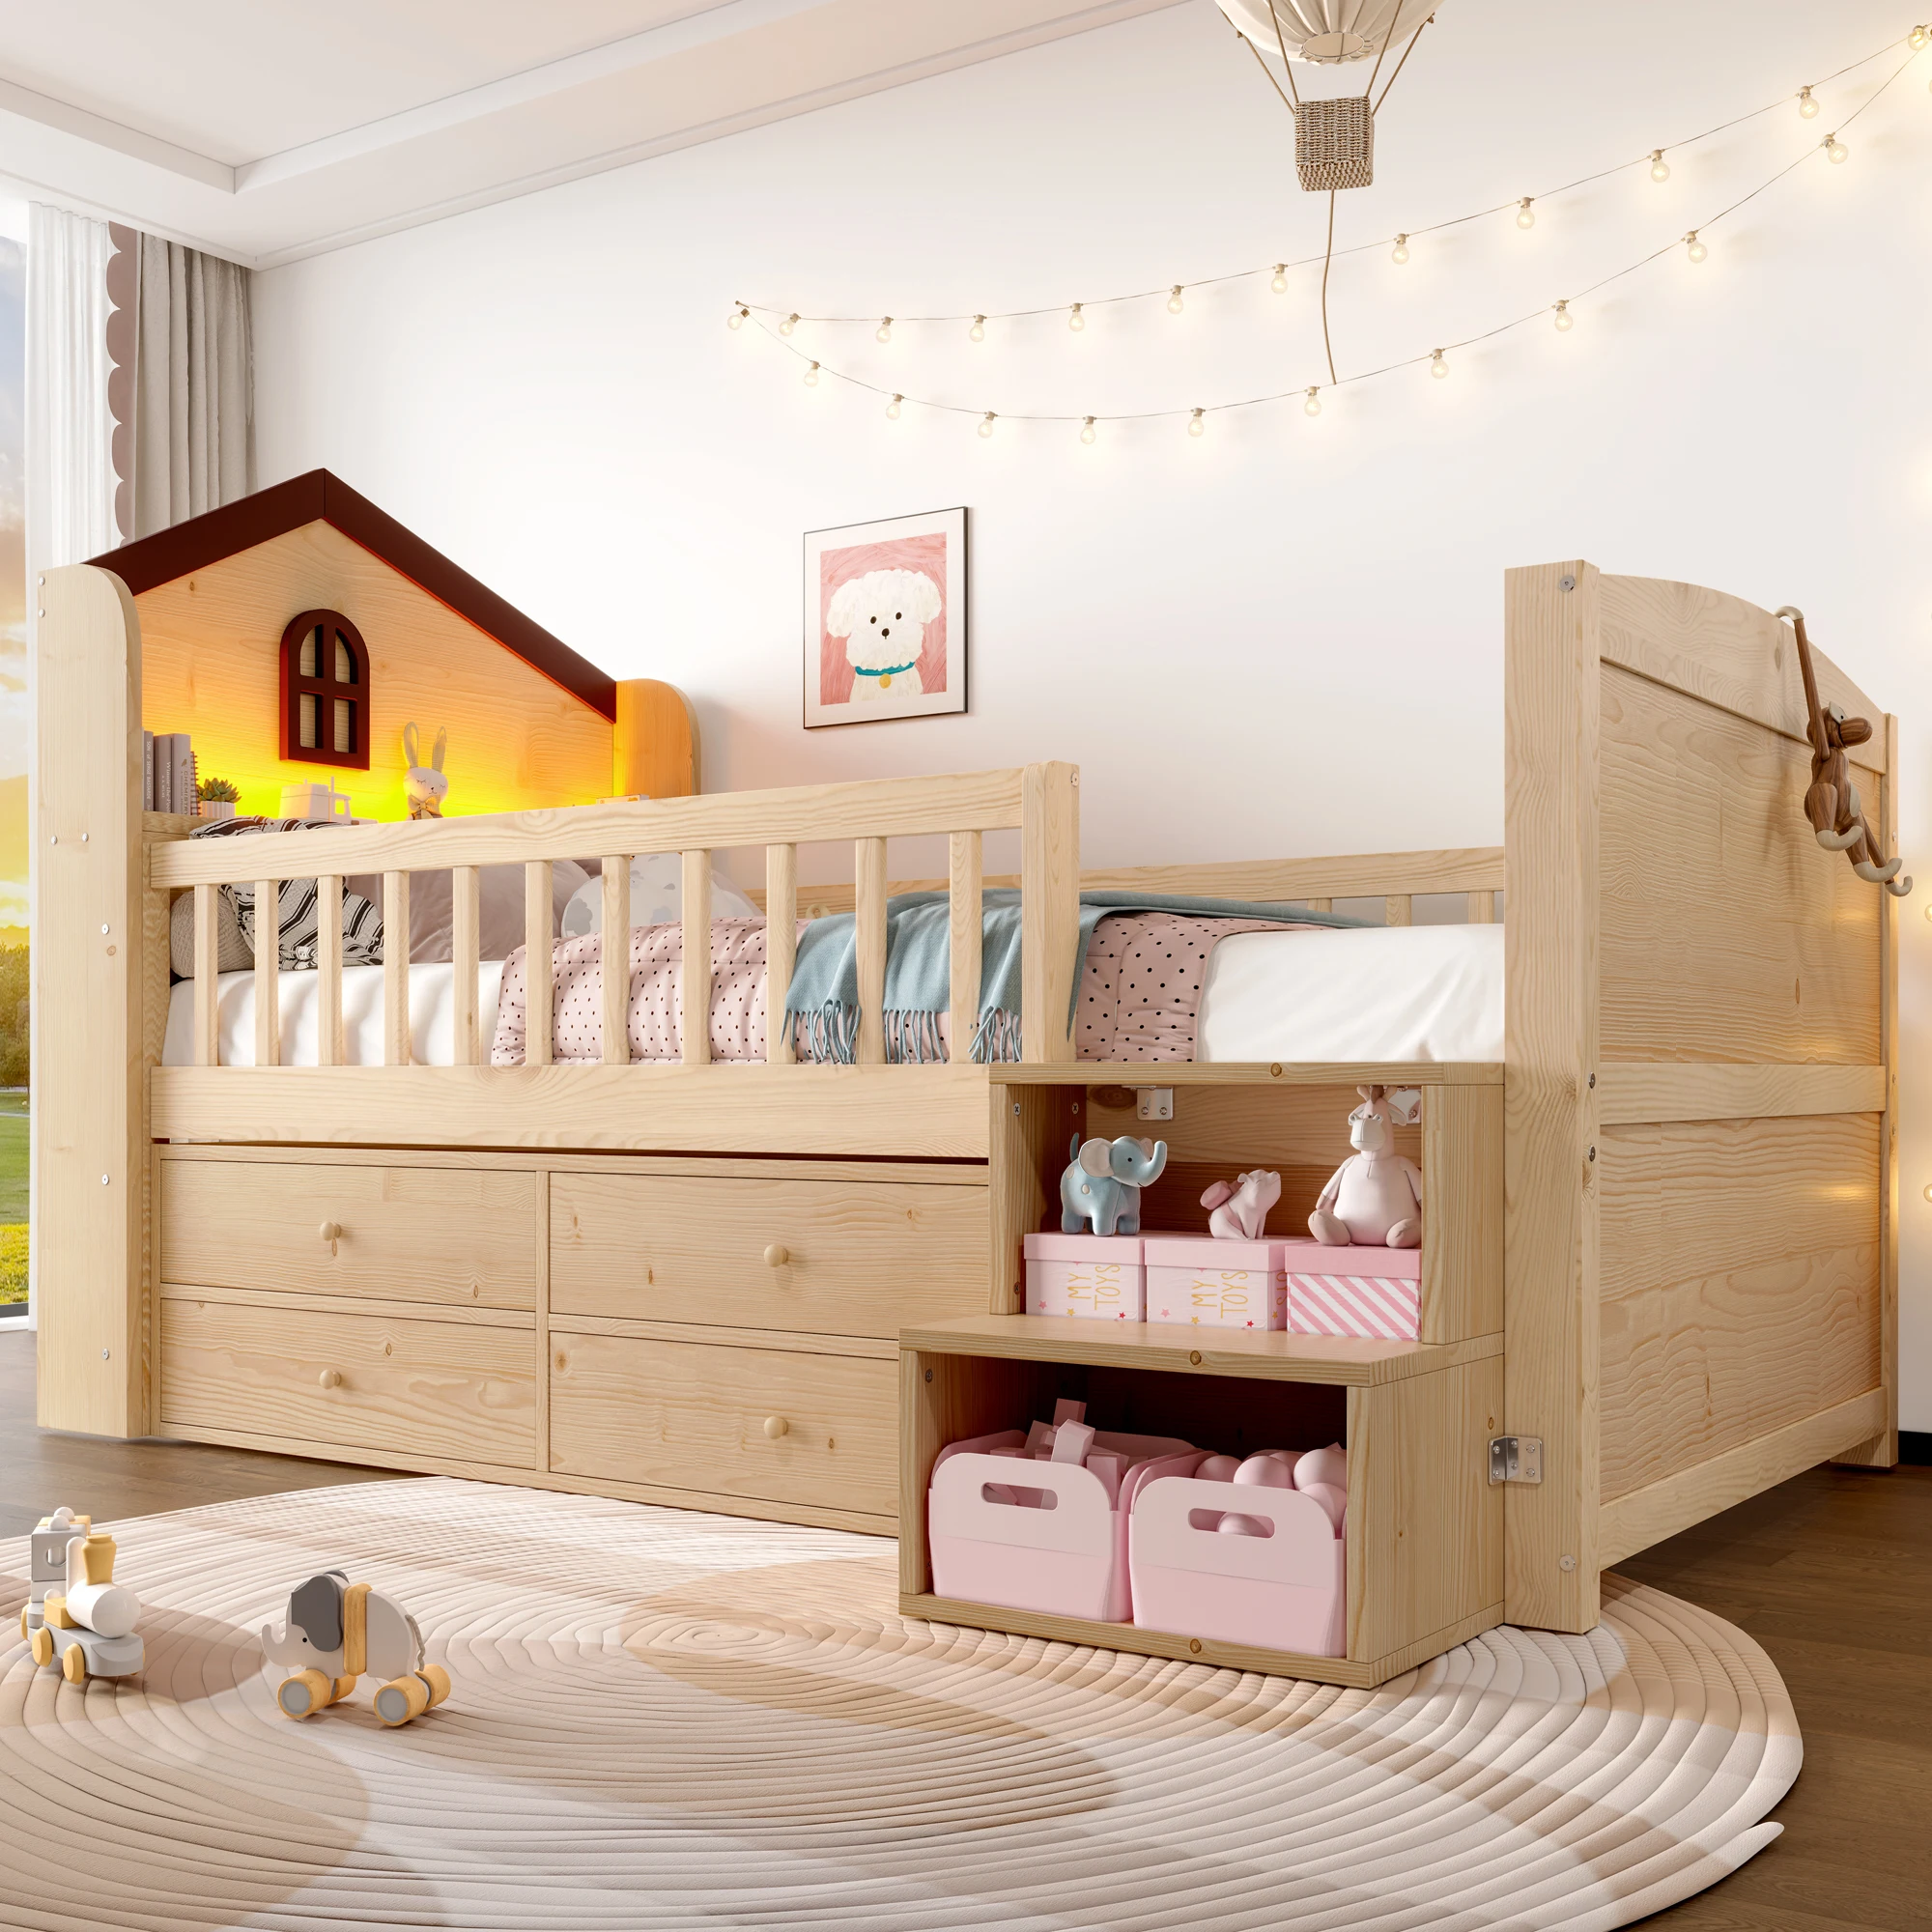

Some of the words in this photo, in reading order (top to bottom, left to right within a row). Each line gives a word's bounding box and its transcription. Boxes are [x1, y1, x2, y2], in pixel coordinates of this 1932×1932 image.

[1066, 1272, 1092, 1299] MY
[1094, 1264, 1121, 1310] TOYS
[1191, 1280, 1217, 1307] MY
[1221, 1270, 1248, 1319] TOYS
